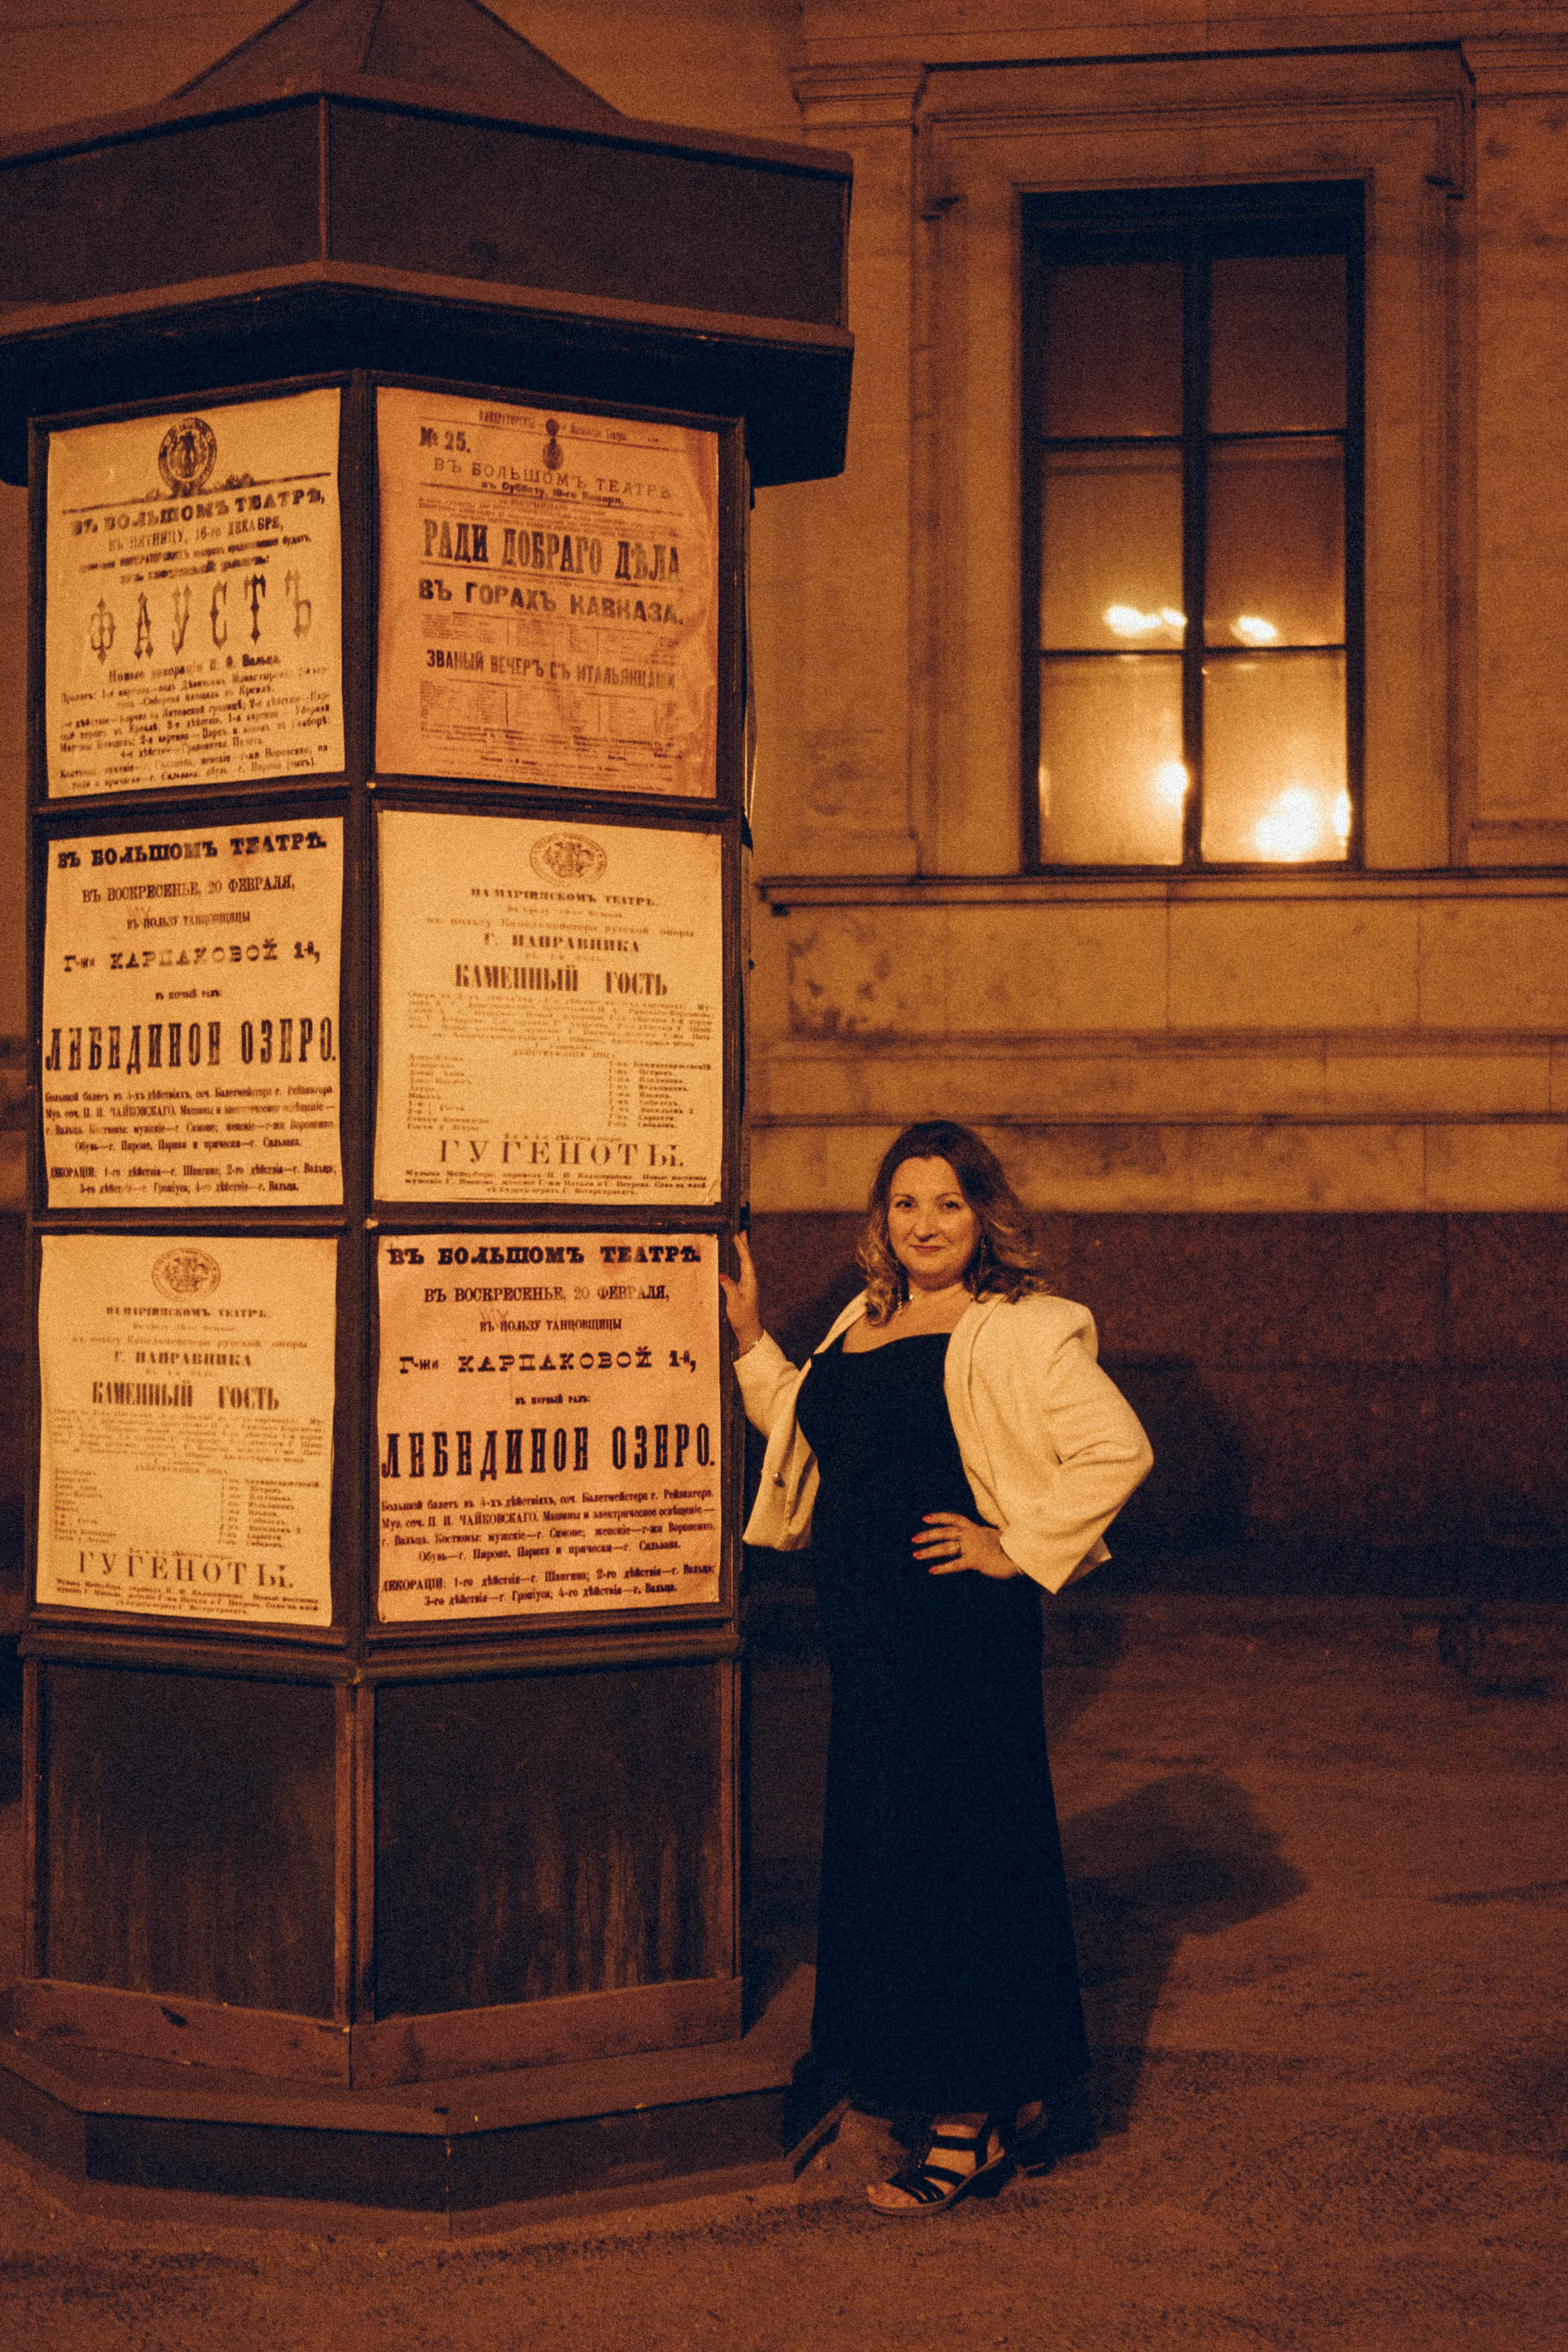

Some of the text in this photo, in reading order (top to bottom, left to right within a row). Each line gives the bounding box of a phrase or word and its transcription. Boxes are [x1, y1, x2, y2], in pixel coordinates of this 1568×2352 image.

[444, 431, 472, 454] 25.
[433, 457, 462, 473] ВЪ
[471, 462, 588, 489] БОЛЬШОМЪ
[104, 499, 230, 532] БОЛЬШОМЪ
[423, 518, 680, 582] РАДИ ДОБРАГО ДѢЛА
[418, 577, 684, 625] ВЪ ГОРАХЪ КАВКАЗА.
[89, 568, 312, 666] ФАУСТЪ
[426, 649, 484, 671] ЗВАНЫЙ
[490, 654, 544, 678] ВЕЧЕРЪ
[549, 661, 570, 680] СЪ
[57, 851, 81, 869] ВЪ
[91, 841, 218, 867] БОЛЬШОМЪ
[82, 875, 295, 903] ВЪ ВОСКРЕСЕНЬЕ, 20 ФЕВРАЛЯ,
[110, 938, 278, 970] КАРПАКОВОЙ
[512, 934, 639, 953] НАПРАВНИКА
[455, 963, 668, 997] КАМЕННЫЙ ГОСТЬ
[45, 1016, 337, 1075] ЛЕБЕДИНОЕ ОЗЕРО.
[440, 1139, 685, 1167] ГУГЕНОТЫ.
[387, 1246, 701, 1265] ВЪ БОЛЬШОМЪ ТЕАТРѢ.
[424, 1285, 669, 1303] ВЪ ВОСКРЕСЕНЬЕ, 20 ФЕВРАЛЯ,
[135, 1351, 251, 1366] НАПРАВНИКА
[400, 1346, 696, 1374] Г-жи КАРПАКОВОЙ 1-й,
[92, 1379, 280, 1411] КАМЕННЫЙ ГОСТЬ
[382, 1427, 588, 1481] ЛЕБЕДИНОЕ
[612, 1423, 715, 1470] ОЗЕРО.
[459, 1512, 539, 1526] ЧАЙКОВСКАГО.
[79, 1550, 294, 1588] ГУГЕНОТЫ.
[596, 1568, 617, 1580] 2-го
